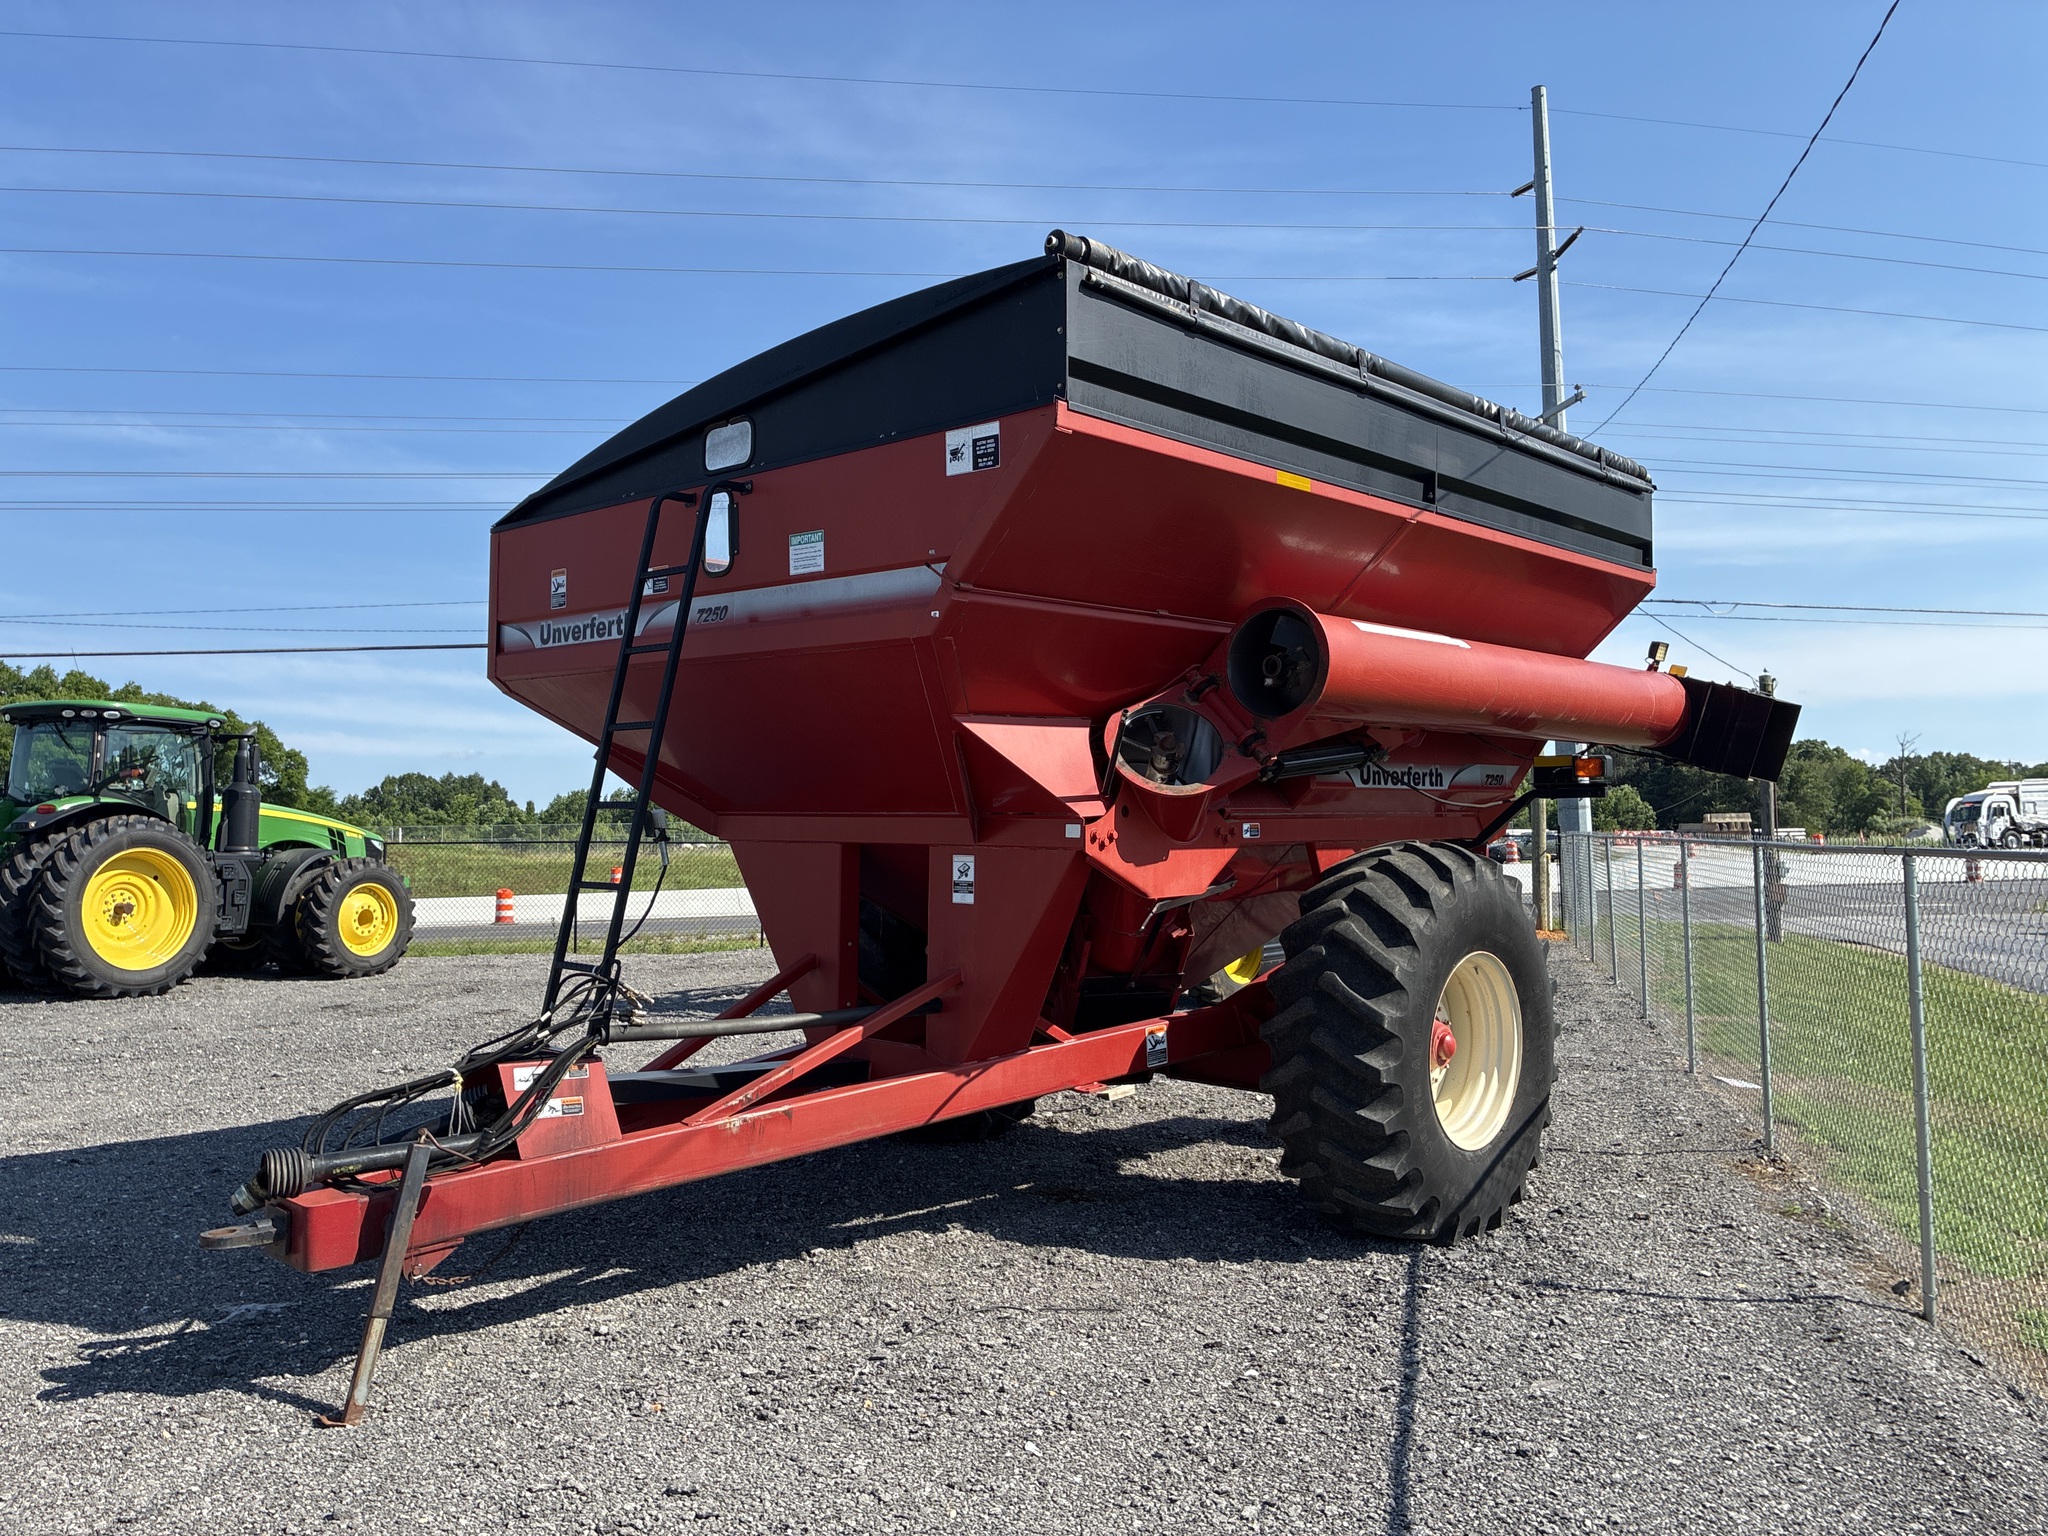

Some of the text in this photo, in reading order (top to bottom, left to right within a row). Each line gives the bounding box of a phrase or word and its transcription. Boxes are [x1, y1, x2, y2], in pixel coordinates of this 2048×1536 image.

[791, 532, 823, 546] IMPORTANT
[696, 605, 729, 624] 7250
[1360, 765, 1504, 787] Unverferth 7250
